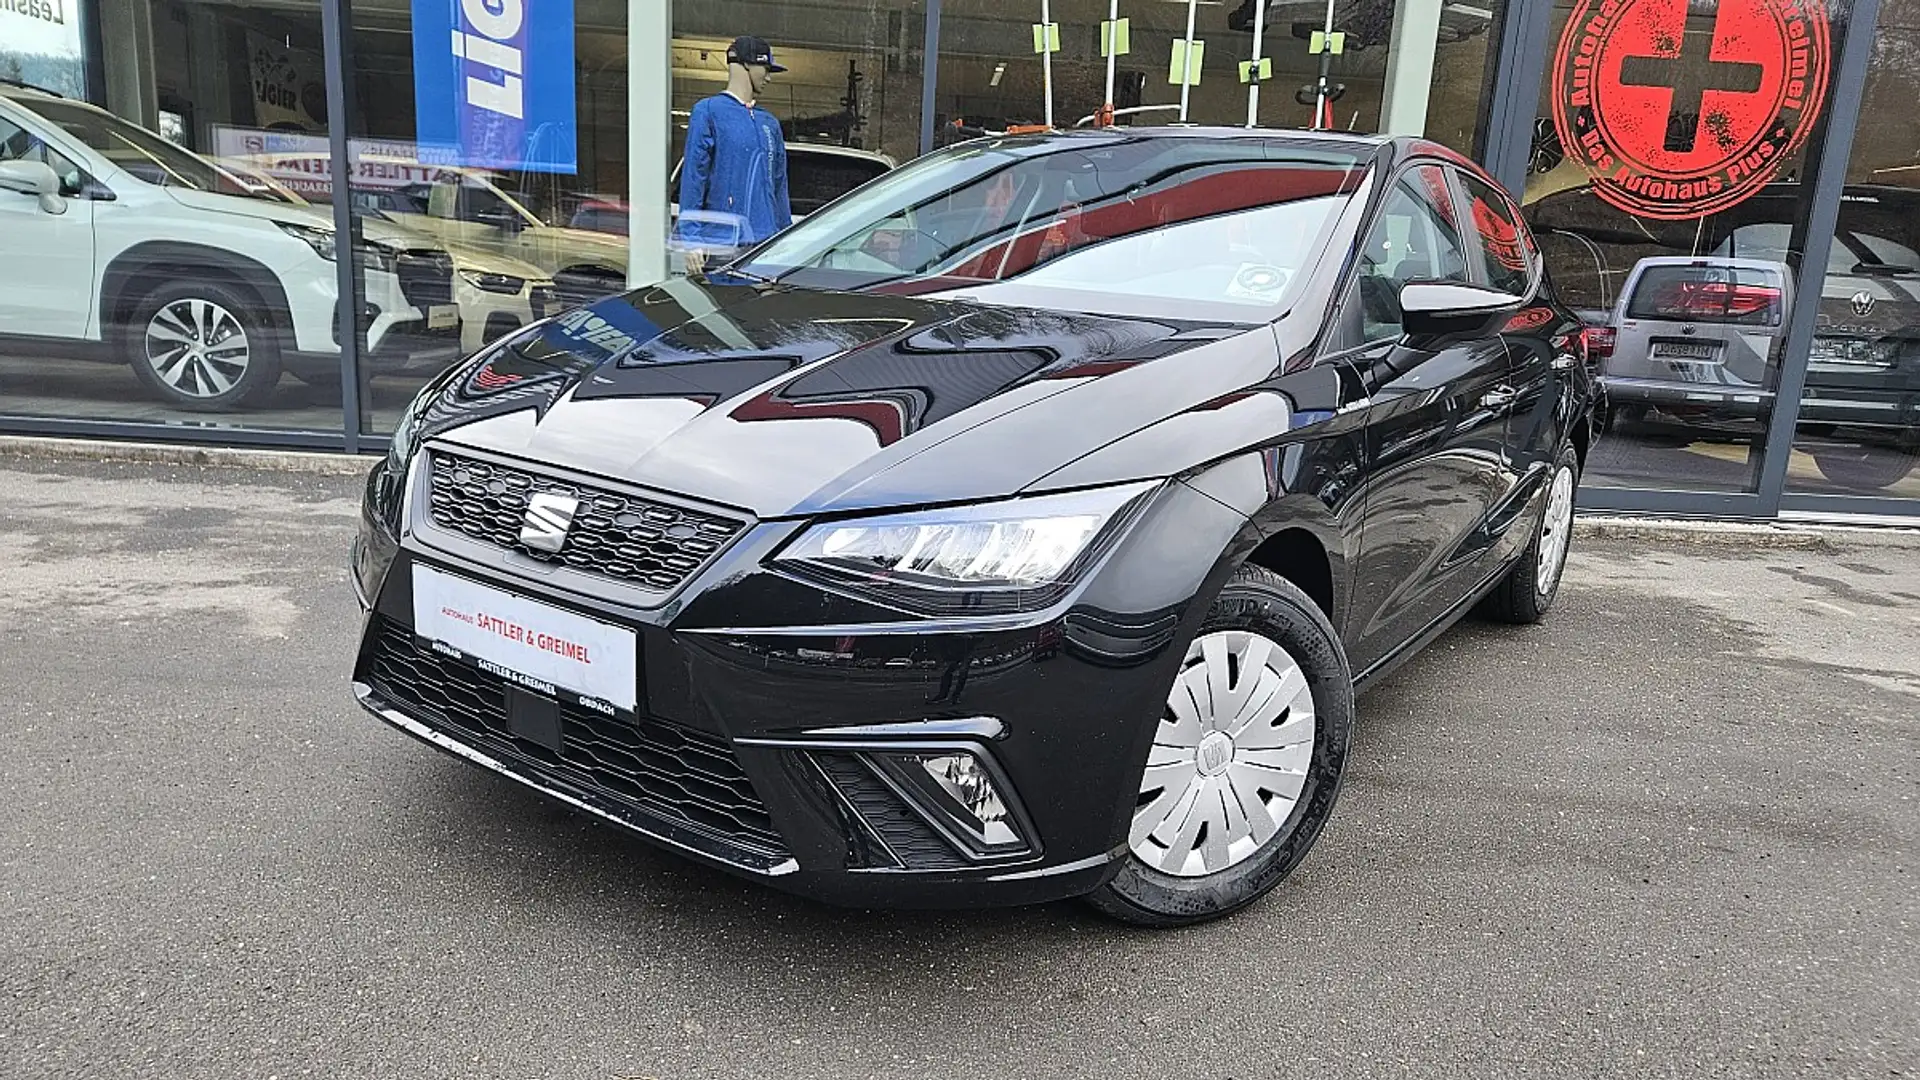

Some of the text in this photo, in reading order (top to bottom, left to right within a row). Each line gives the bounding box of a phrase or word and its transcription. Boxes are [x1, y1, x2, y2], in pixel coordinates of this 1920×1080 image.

[1581, 128, 1775, 200] Das Autohaus Plus
[477, 613, 524, 642] SATTLER
[526, 630, 534, 646] &
[537, 633, 591, 664] GREIMEL
[477, 659, 511, 679] SATTLER
[518, 674, 557, 695] GREIMEL
[578, 696, 615, 716] OBDACH
